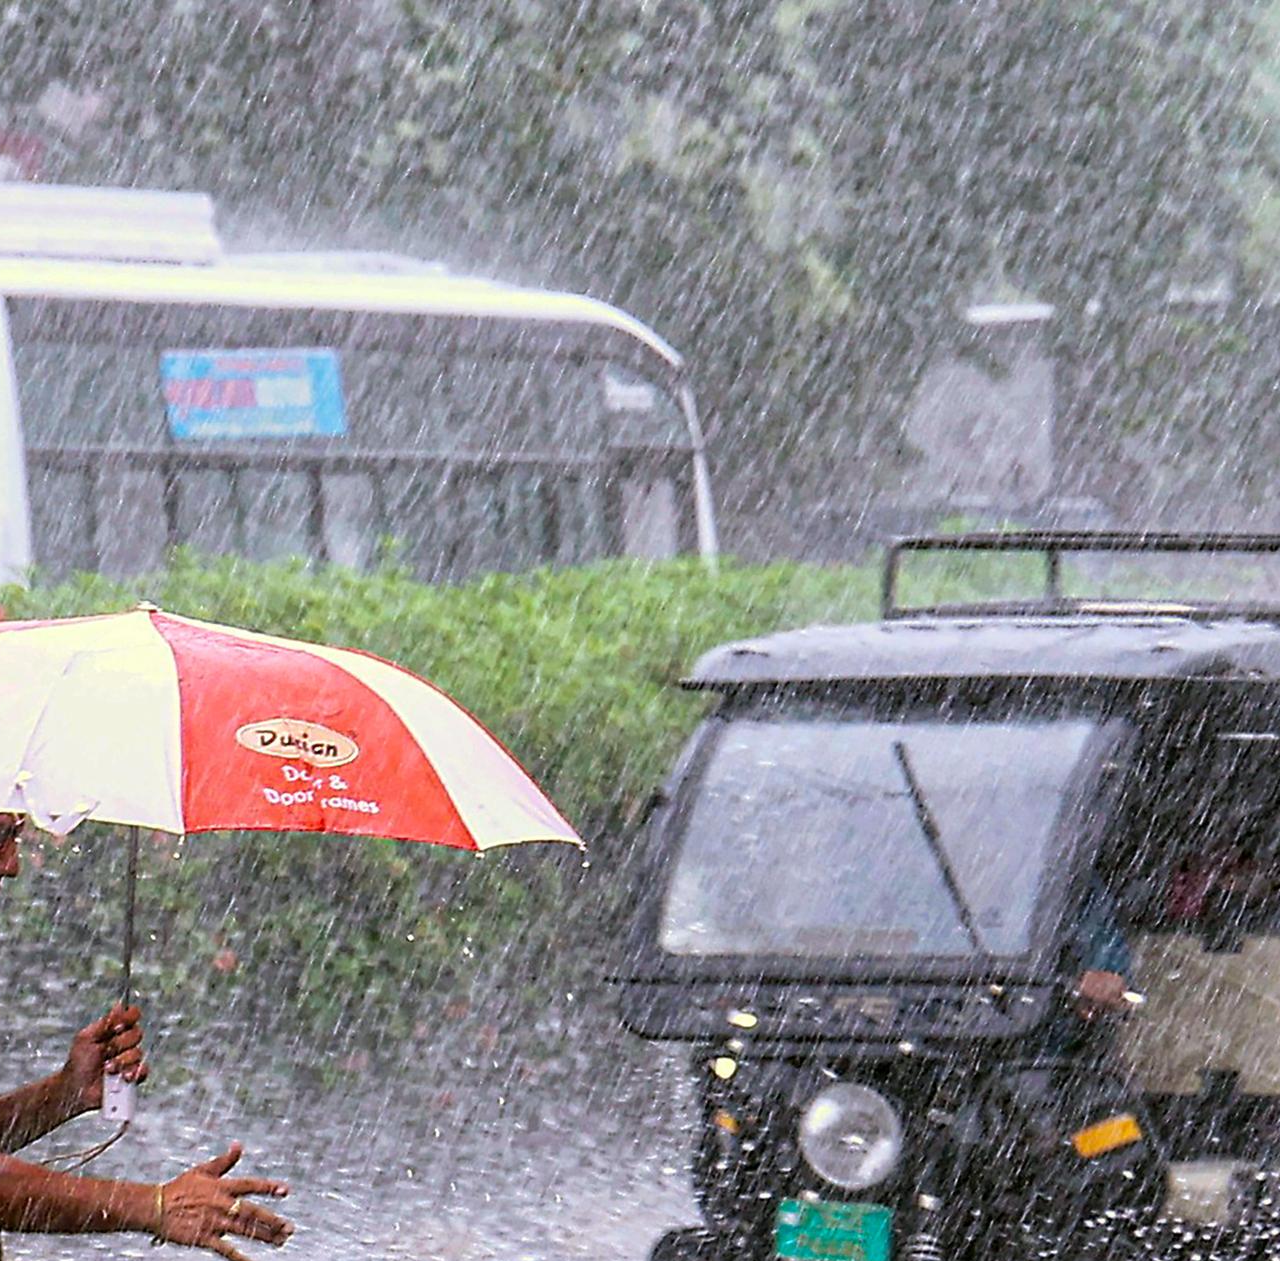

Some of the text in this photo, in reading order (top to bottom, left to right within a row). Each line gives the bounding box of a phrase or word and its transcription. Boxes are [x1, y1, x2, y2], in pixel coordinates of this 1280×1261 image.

[328, 774, 348, 790] &
[263, 787, 380, 814] Door rames
